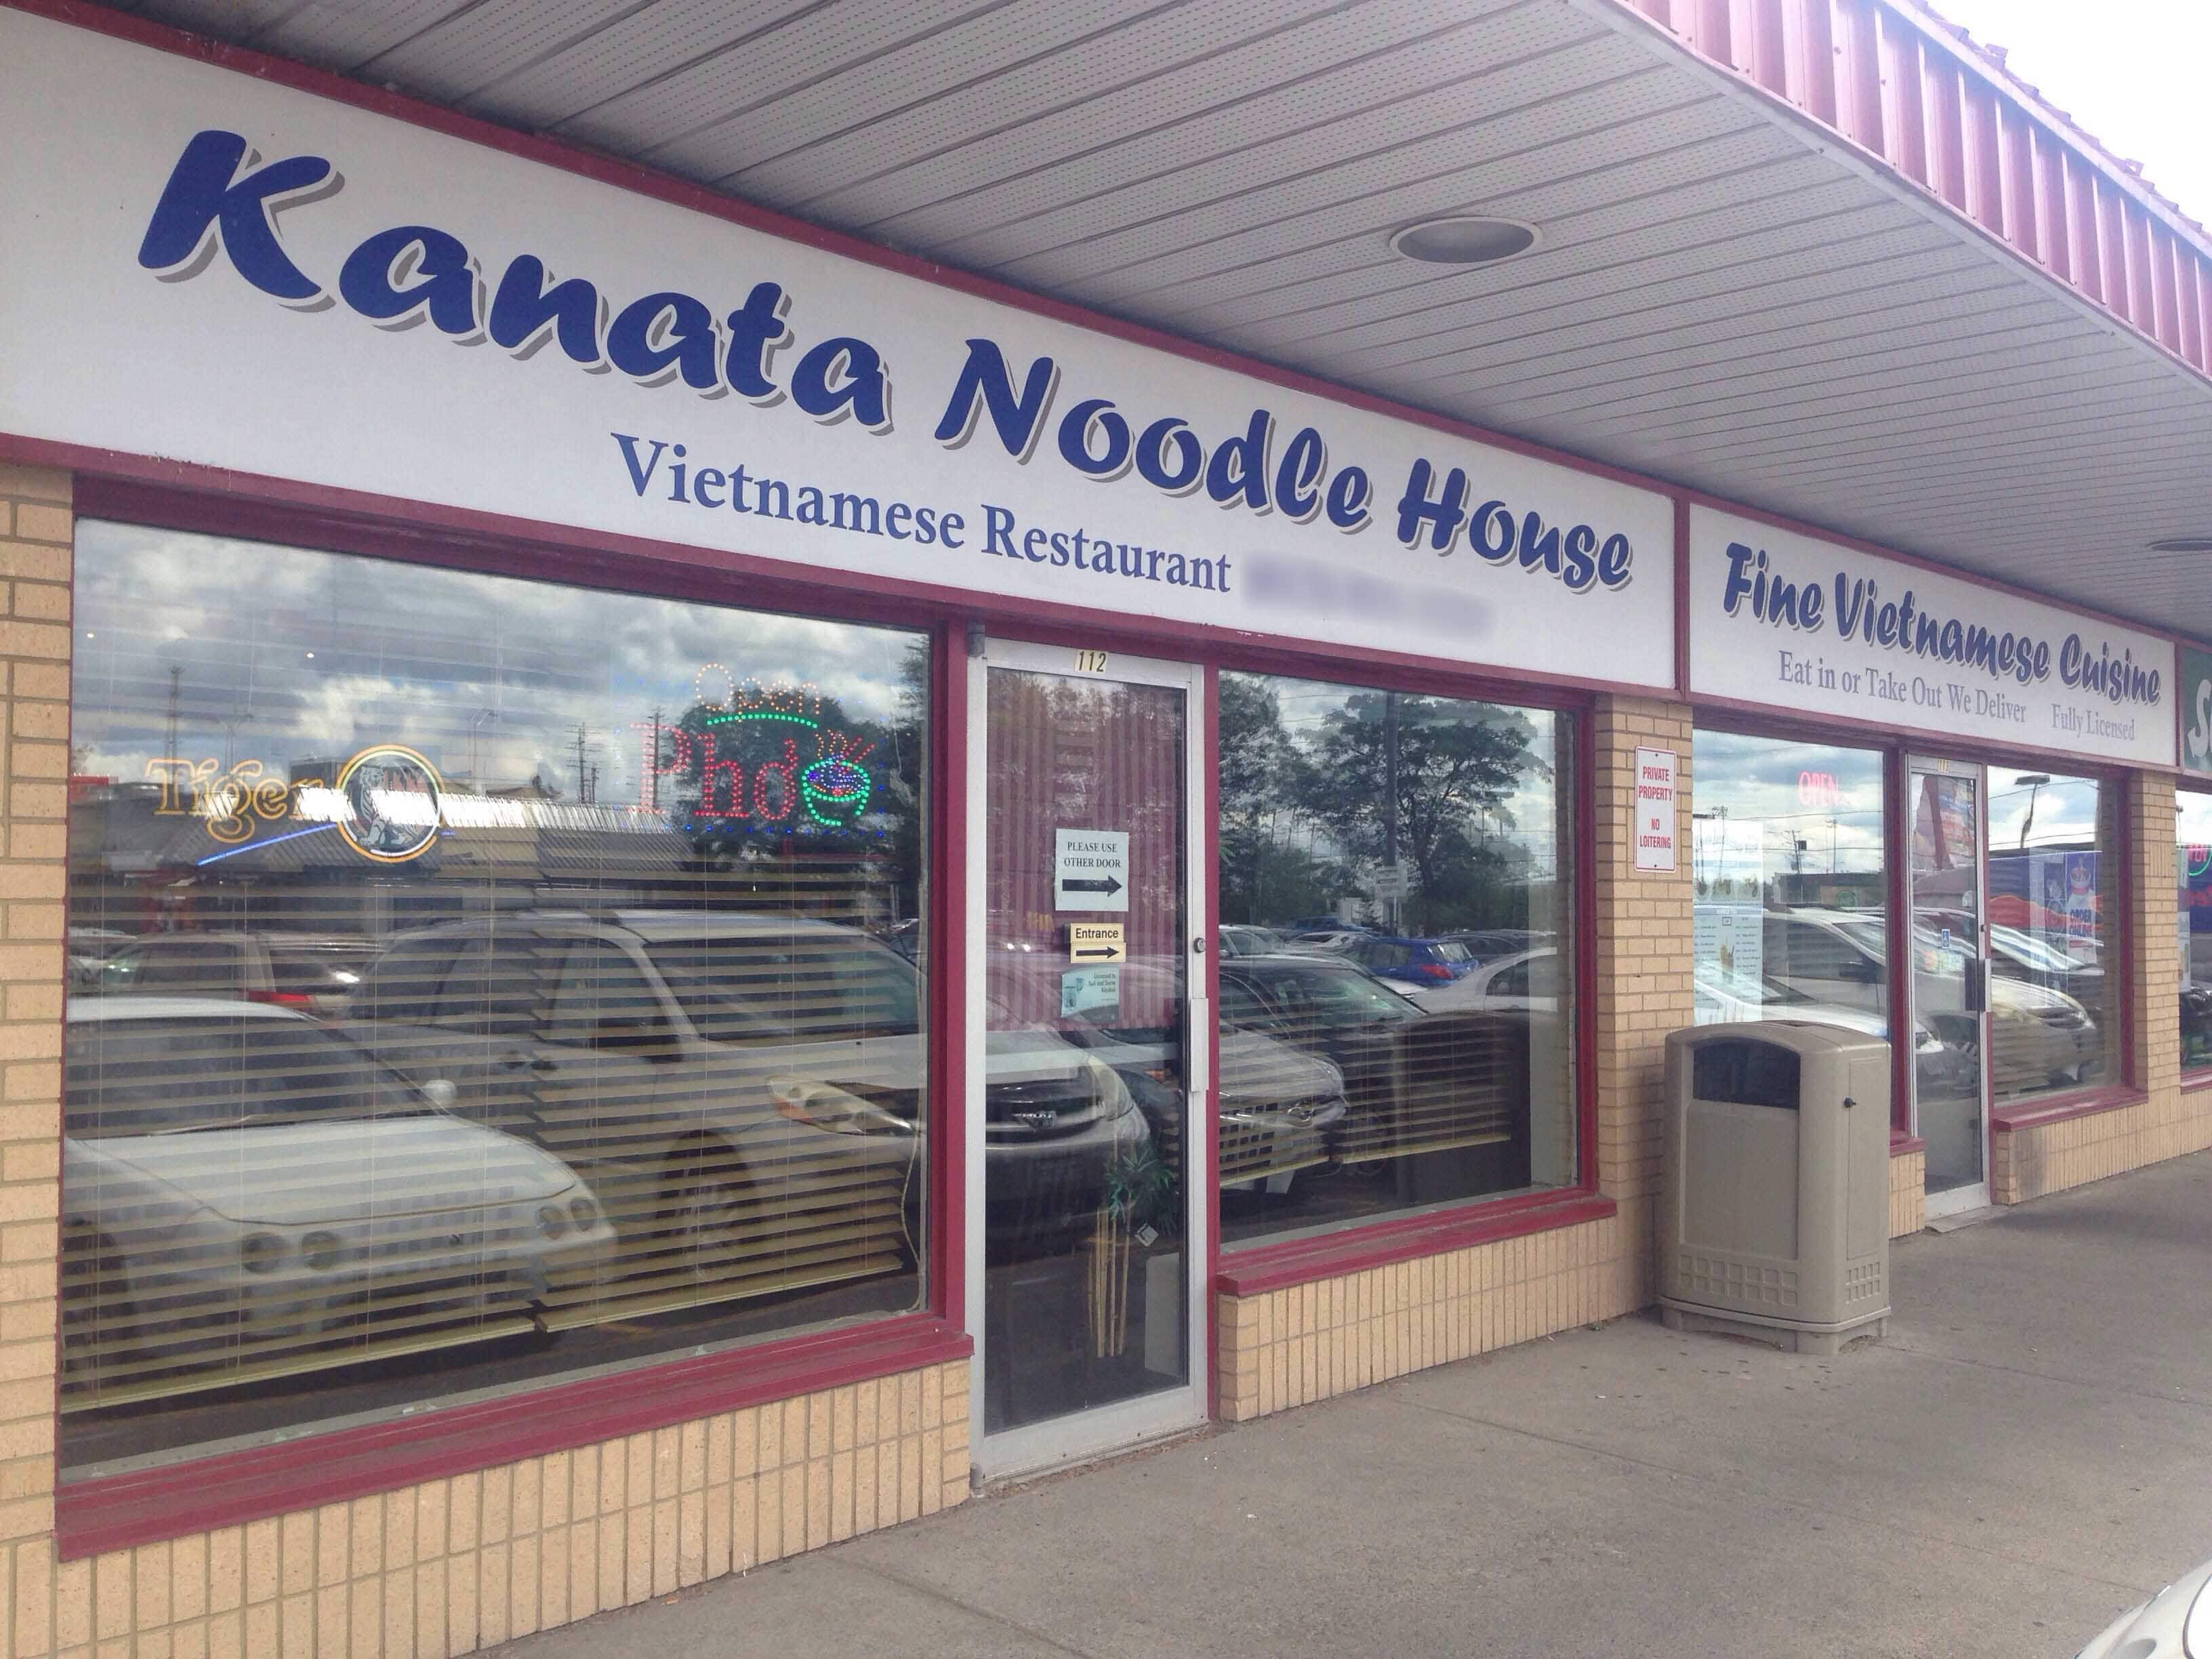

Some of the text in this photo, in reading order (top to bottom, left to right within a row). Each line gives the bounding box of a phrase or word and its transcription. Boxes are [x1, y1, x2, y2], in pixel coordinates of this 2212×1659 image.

[138, 130, 1633, 594] Kanata Noodle House
[611, 432, 1230, 592] Vietnamese Restaurant
[1723, 542, 2161, 705] Fine Vietnamese Cuisine
[1079, 651, 1106, 672] 112
[695, 662, 820, 722] Open
[1778, 651, 2026, 722] Eat in or Take Out We Deliver
[2052, 703, 2135, 741] Fully Licensed
[1643, 766, 1669, 781] PRIVATE
[1639, 785, 1673, 801] PROPERTY
[1651, 818, 1660, 830] NO
[1067, 841, 1117, 853] PLEASE USE
[1640, 835, 1671, 848] LOITERING
[1064, 858, 1121, 868] OTHER DOOR
[1076, 928, 1119, 939] Entrance
